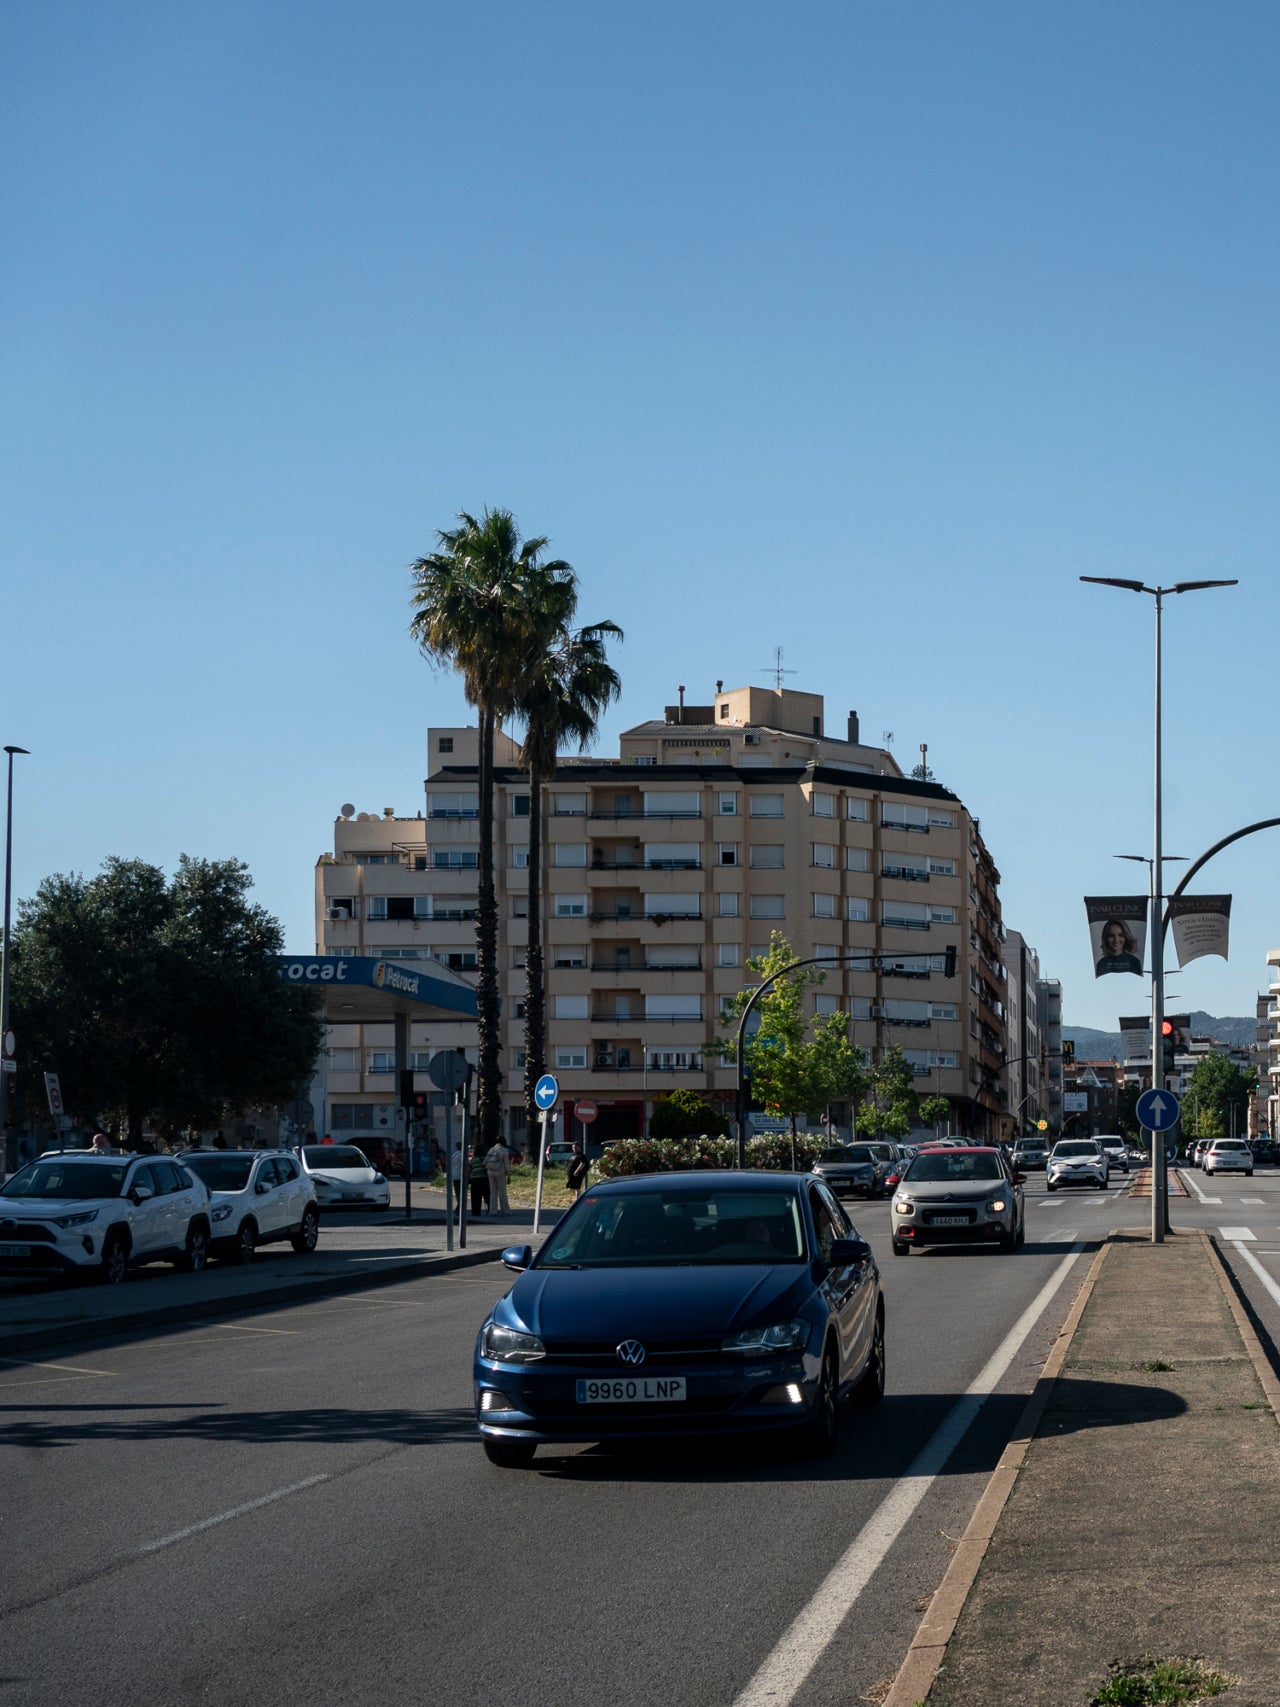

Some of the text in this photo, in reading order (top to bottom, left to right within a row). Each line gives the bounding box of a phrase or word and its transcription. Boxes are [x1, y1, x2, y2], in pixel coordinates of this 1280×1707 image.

[387, 967, 419, 994] Petrocat
[588, 1380, 680, 1399] 9960 LNP
